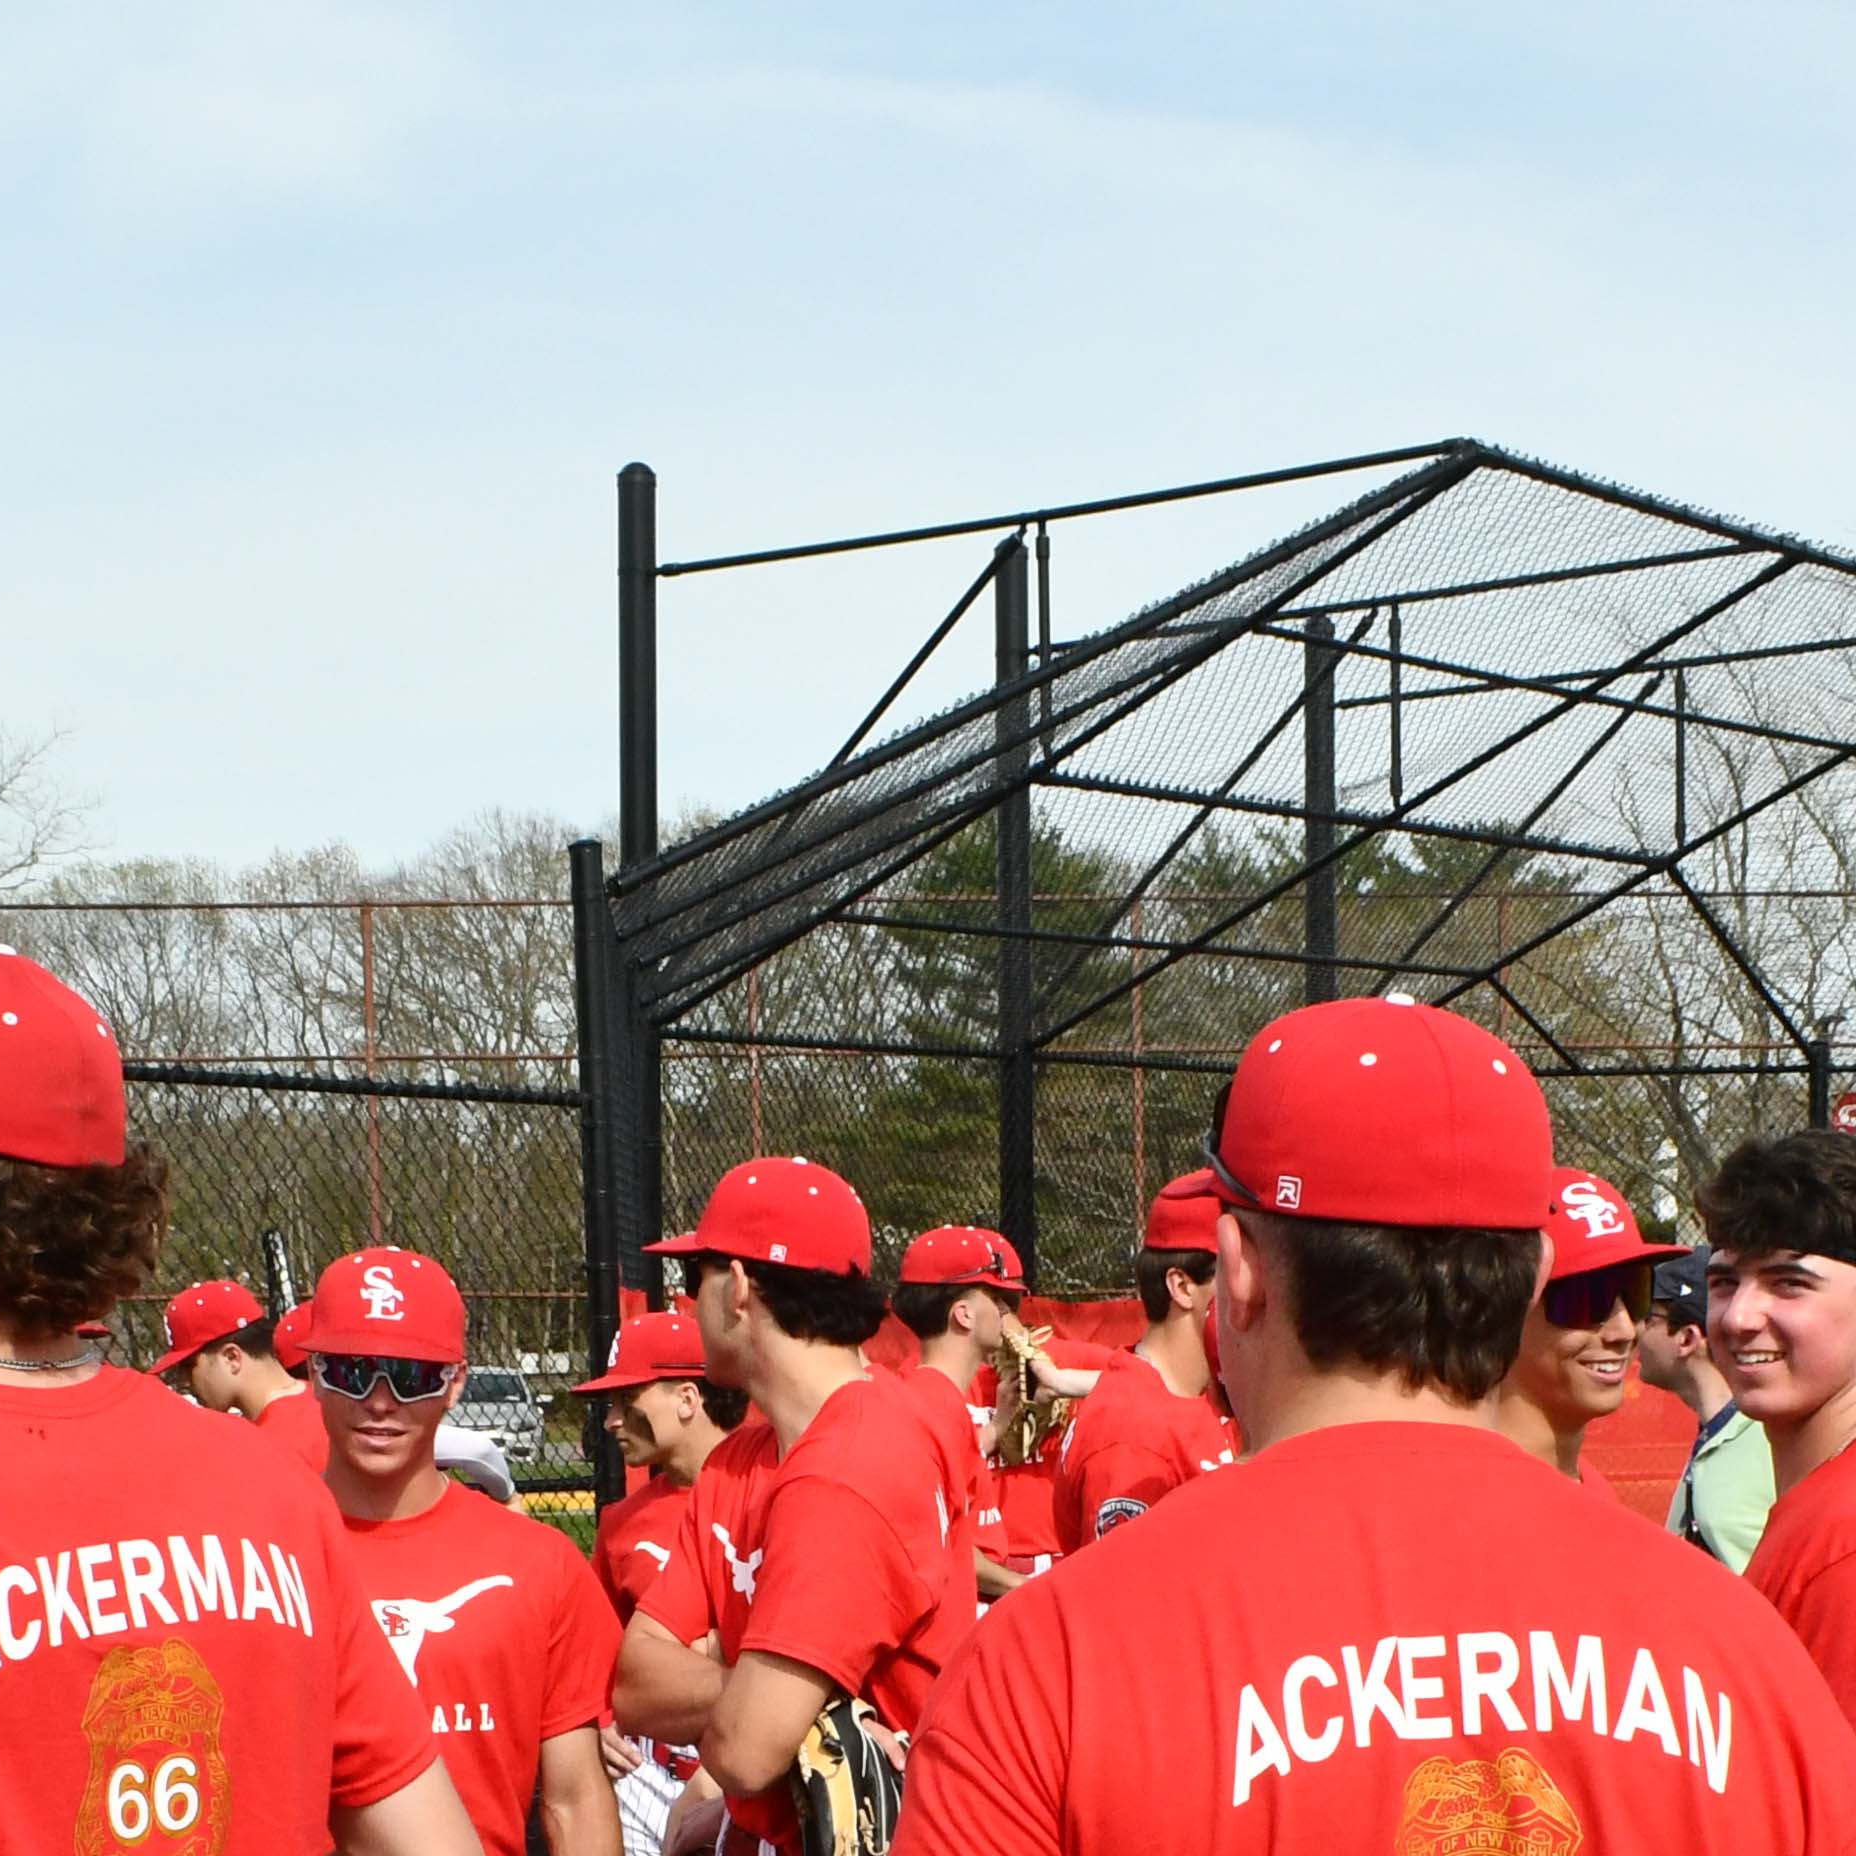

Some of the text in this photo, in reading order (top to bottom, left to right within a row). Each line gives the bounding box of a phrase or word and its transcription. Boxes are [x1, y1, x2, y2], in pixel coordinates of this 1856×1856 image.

[1562, 1181, 1624, 1238] SE
[360, 1266, 404, 1321] SE
[1232, 1631, 1731, 1808] ACKERMAN
[108, 1755, 200, 1841] 66
[1441, 1836, 1460, 1854] OF
[1464, 1831, 1505, 1848] NEW
